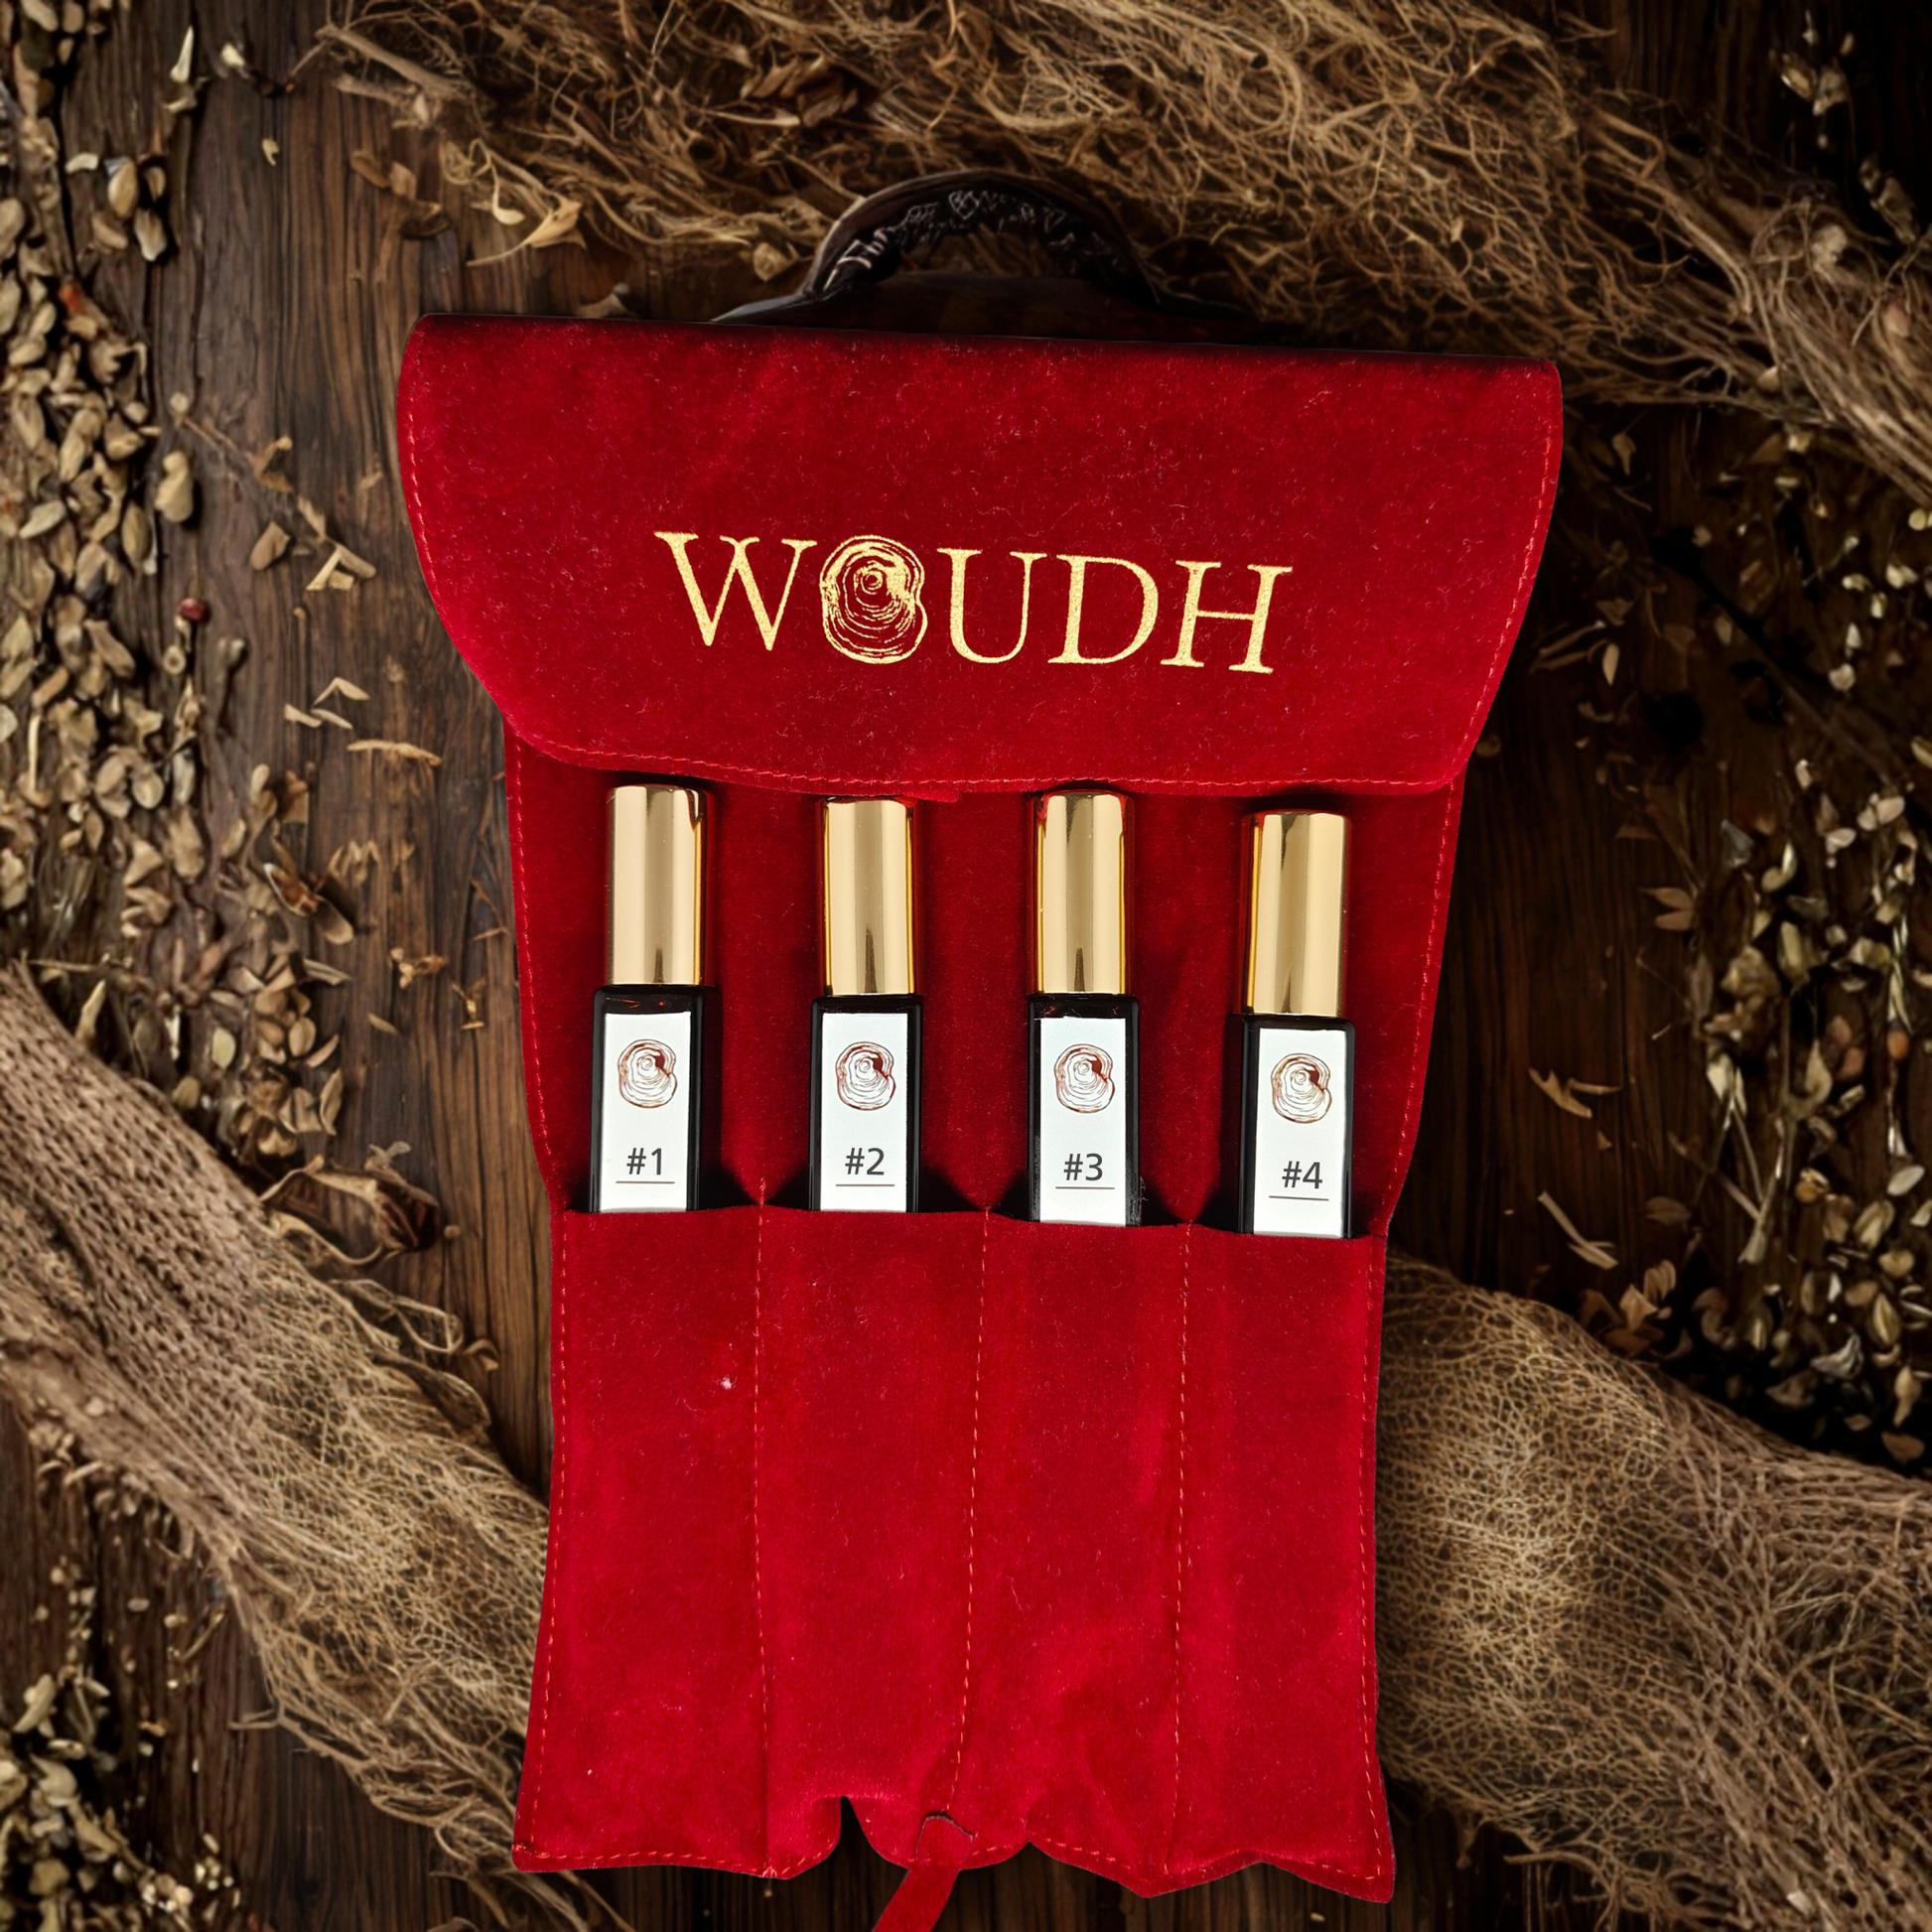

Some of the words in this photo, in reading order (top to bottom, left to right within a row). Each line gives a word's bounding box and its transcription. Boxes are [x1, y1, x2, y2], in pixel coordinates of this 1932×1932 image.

[627, 1148, 661, 1174] #1
[845, 1148, 884, 1174] #2
[1064, 1154, 1102, 1180] #3
[1283, 1162, 1322, 1188] #4
